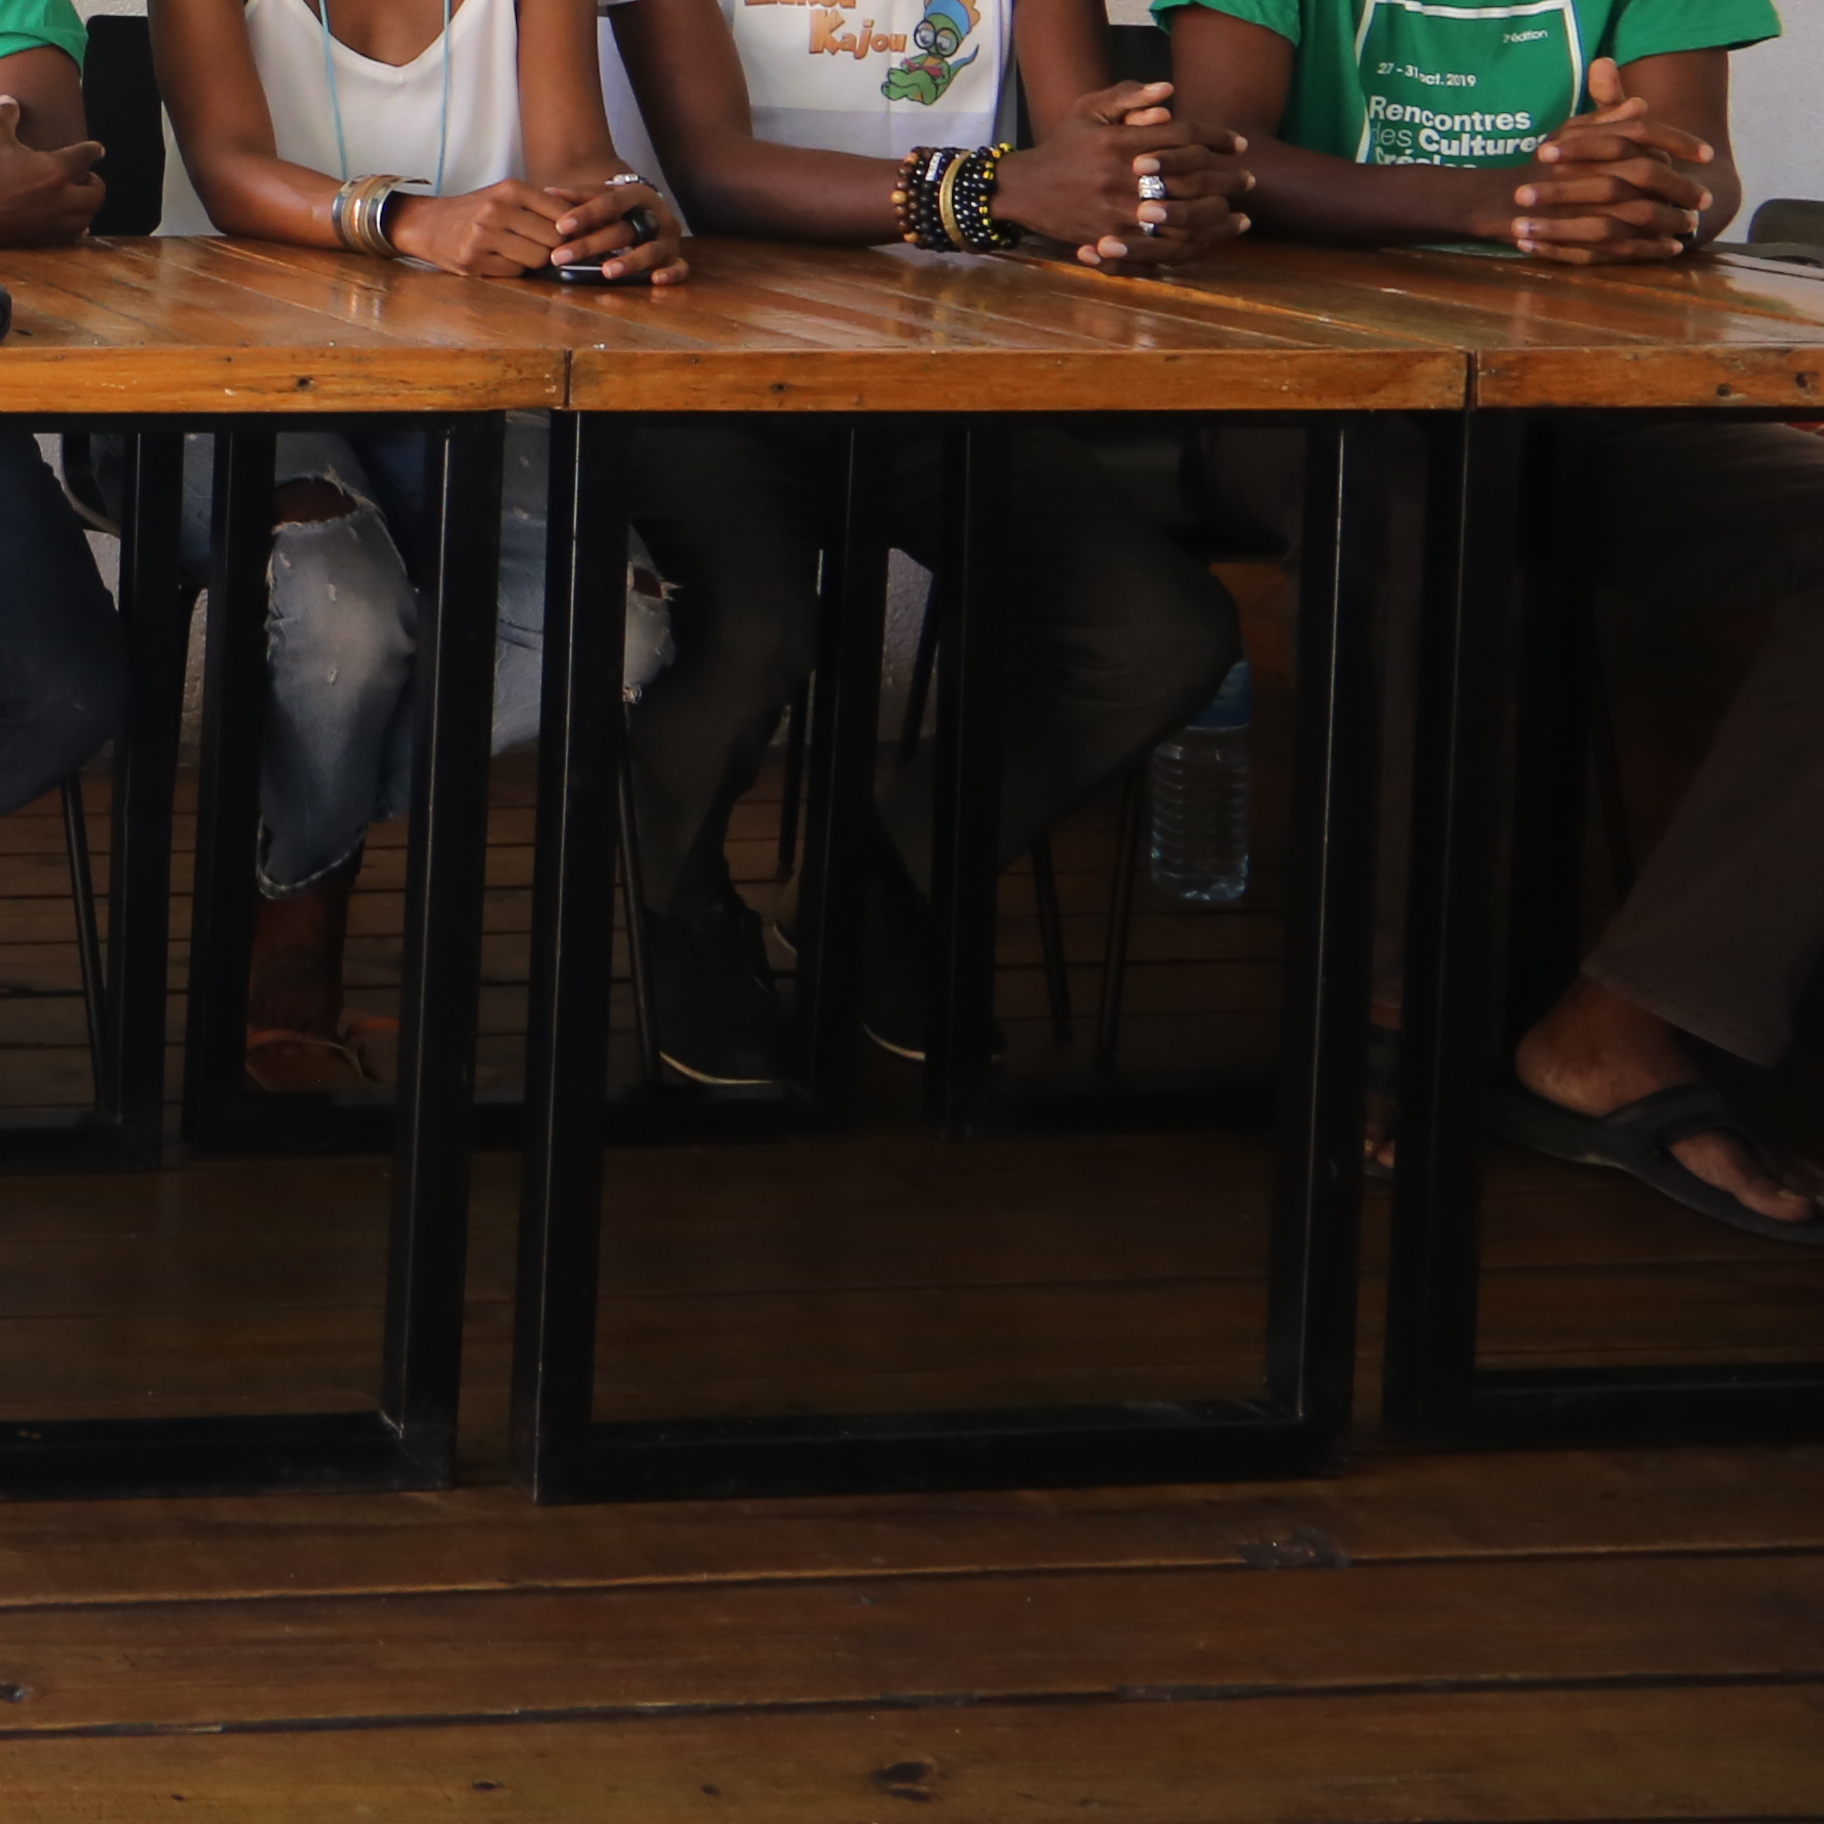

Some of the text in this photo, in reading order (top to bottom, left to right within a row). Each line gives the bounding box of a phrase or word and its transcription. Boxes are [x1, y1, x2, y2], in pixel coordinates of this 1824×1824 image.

[809, 9, 908, 60] Kajou
[1376, 61, 1394, 75] 27
[1404, 64, 1419, 79] 31
[1445, 73, 1477, 88] 2019
[1368, 95, 1532, 133] Rencontres
